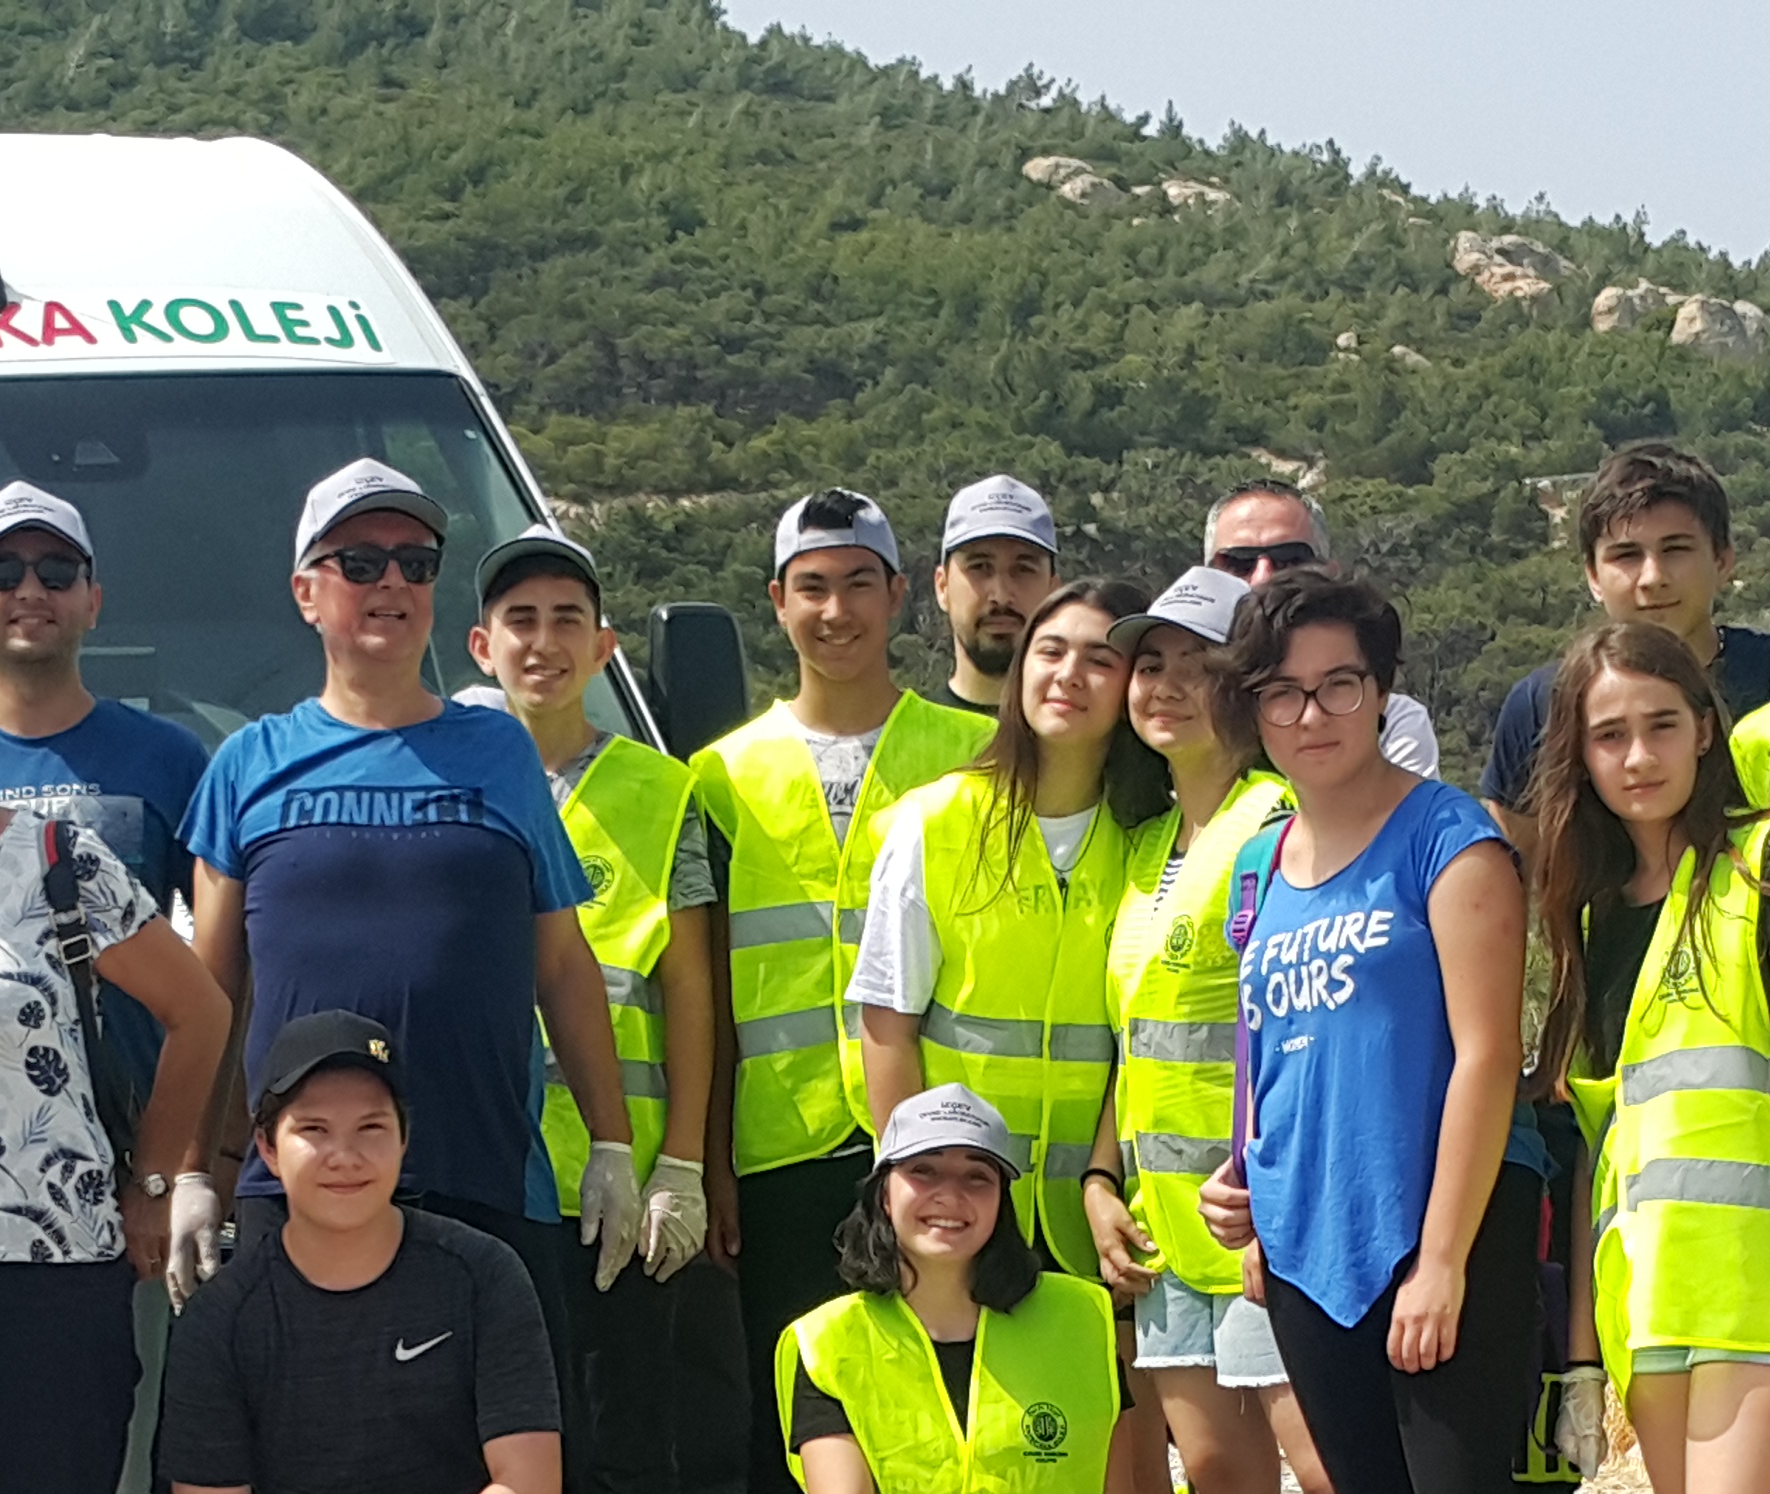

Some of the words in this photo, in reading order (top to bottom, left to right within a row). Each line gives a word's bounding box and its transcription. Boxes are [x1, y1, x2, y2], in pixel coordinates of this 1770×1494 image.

[41, 783, 102, 797] SONS
[1260, 910, 1394, 976] FUTURE
[1265, 954, 1355, 1017] OURS
